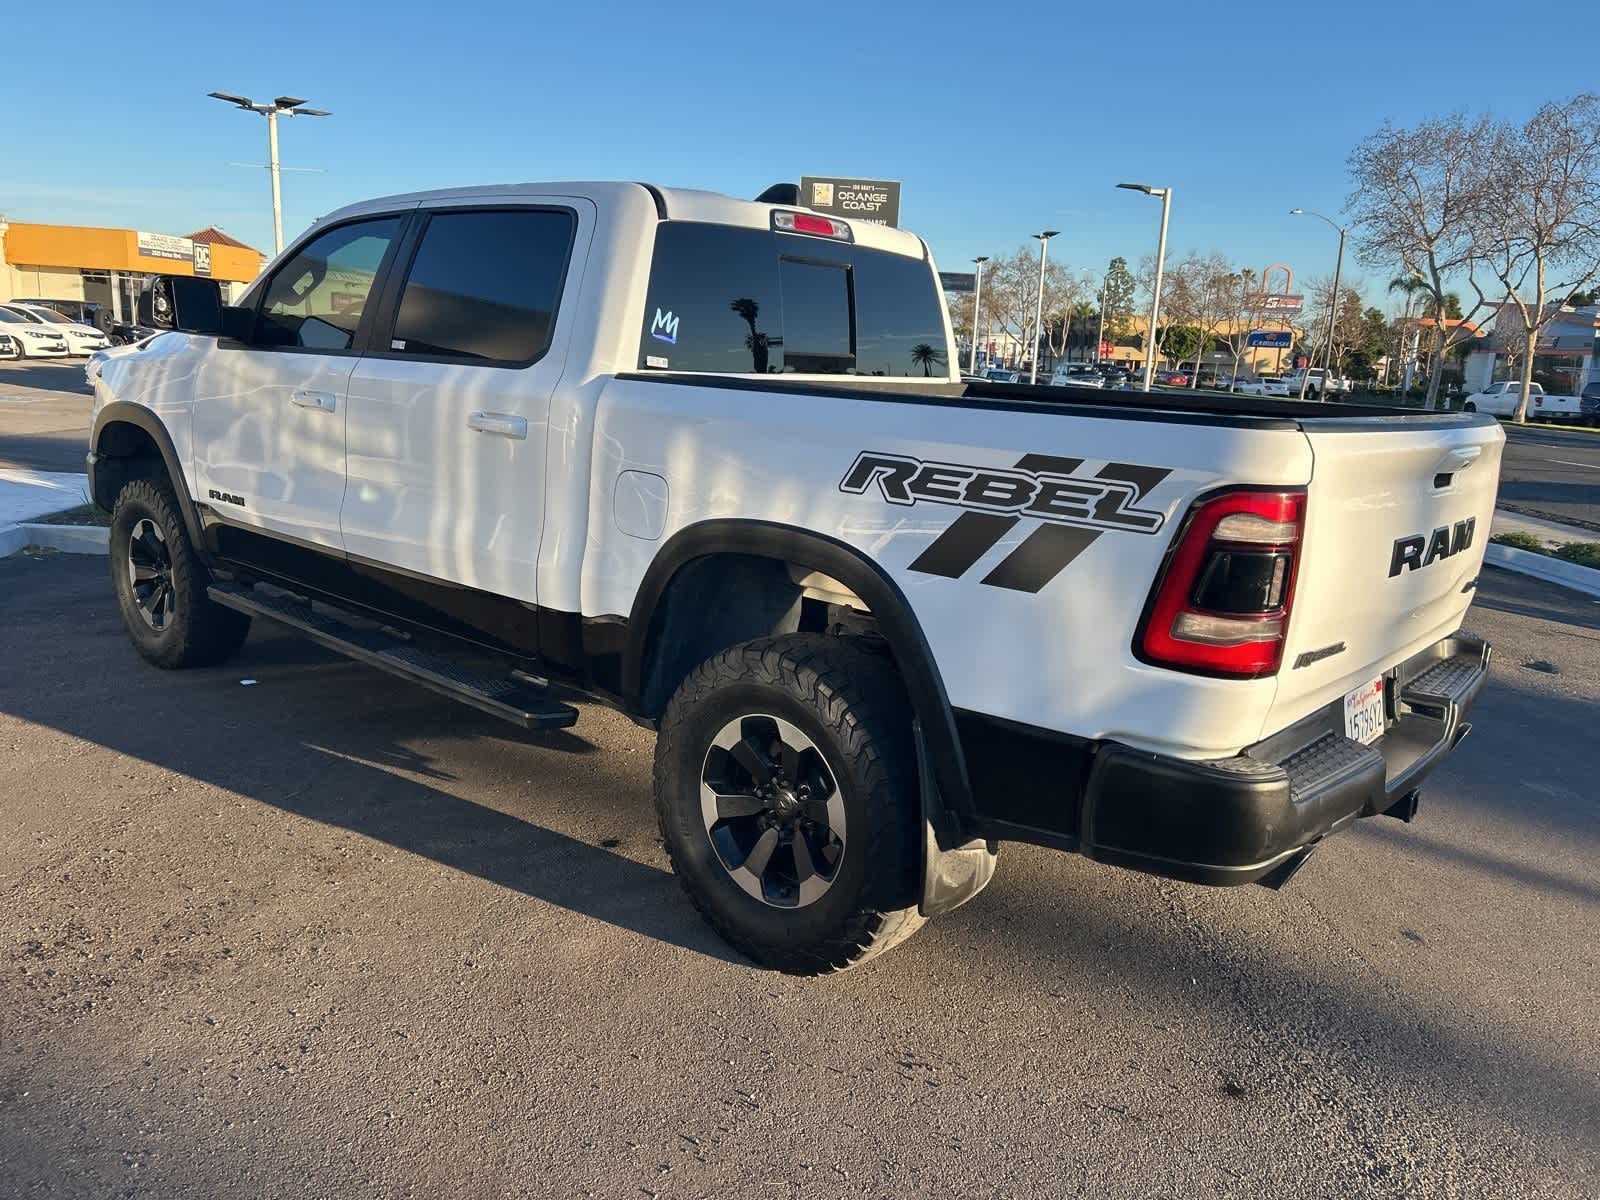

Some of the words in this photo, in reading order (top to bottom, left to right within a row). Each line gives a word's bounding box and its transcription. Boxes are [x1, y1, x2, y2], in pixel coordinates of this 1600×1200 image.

[838, 191, 888, 203] ORANGE
[842, 201, 882, 212] COAST
[208, 489, 246, 507] RAM
[839, 450, 1165, 534] REBEL
[1388, 516, 1476, 578] RAM
